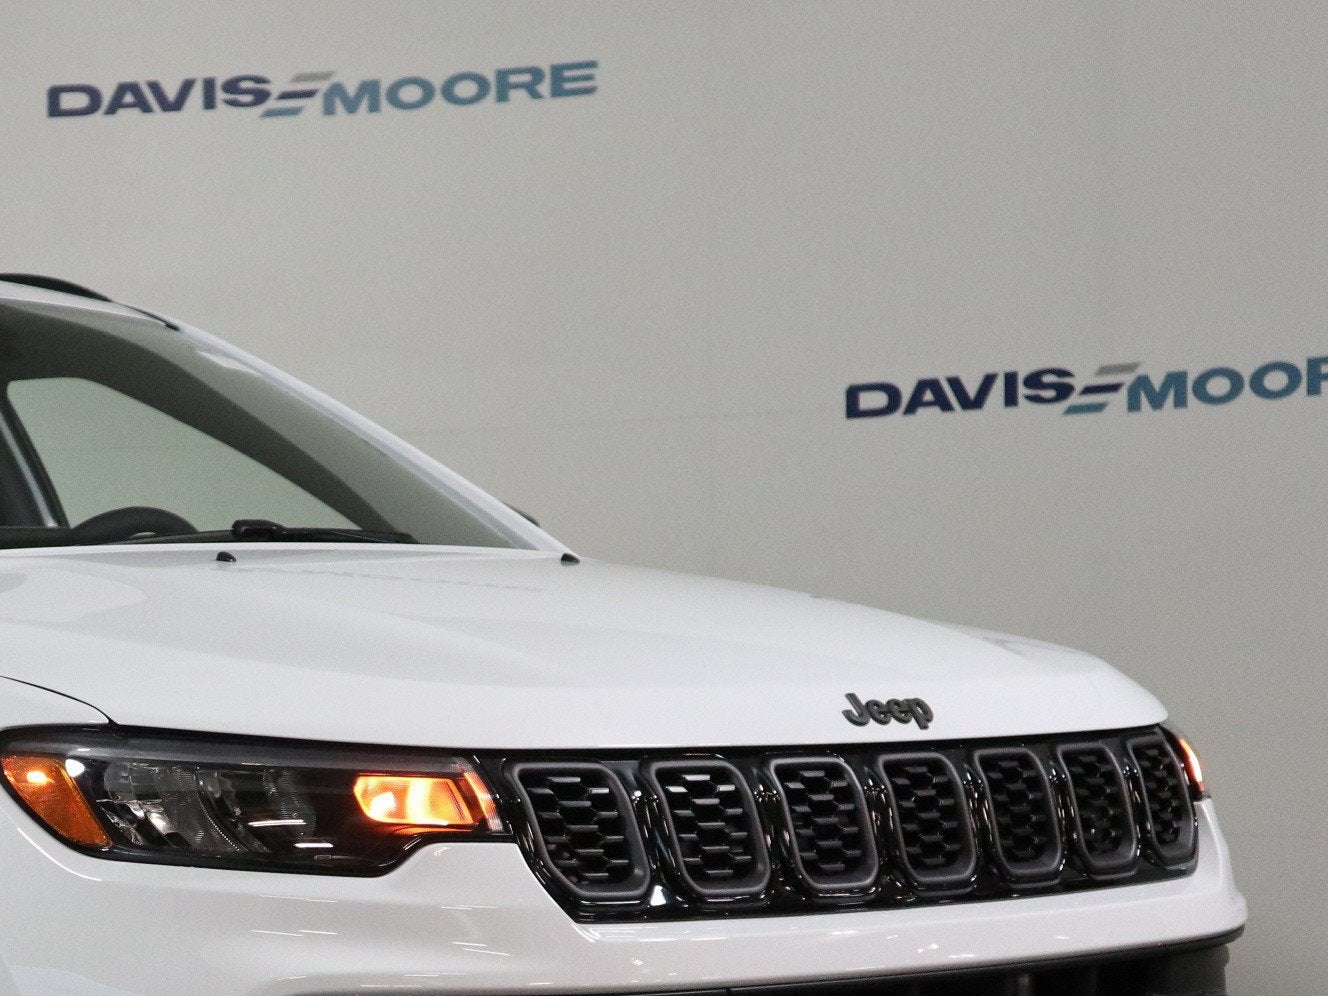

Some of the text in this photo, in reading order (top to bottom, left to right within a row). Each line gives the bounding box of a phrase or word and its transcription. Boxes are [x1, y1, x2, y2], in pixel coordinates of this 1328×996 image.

[46, 59, 598, 118] DAVIS MOORE
[845, 367, 1075, 419] DAVIS
[842, 692, 934, 730] Jeep
